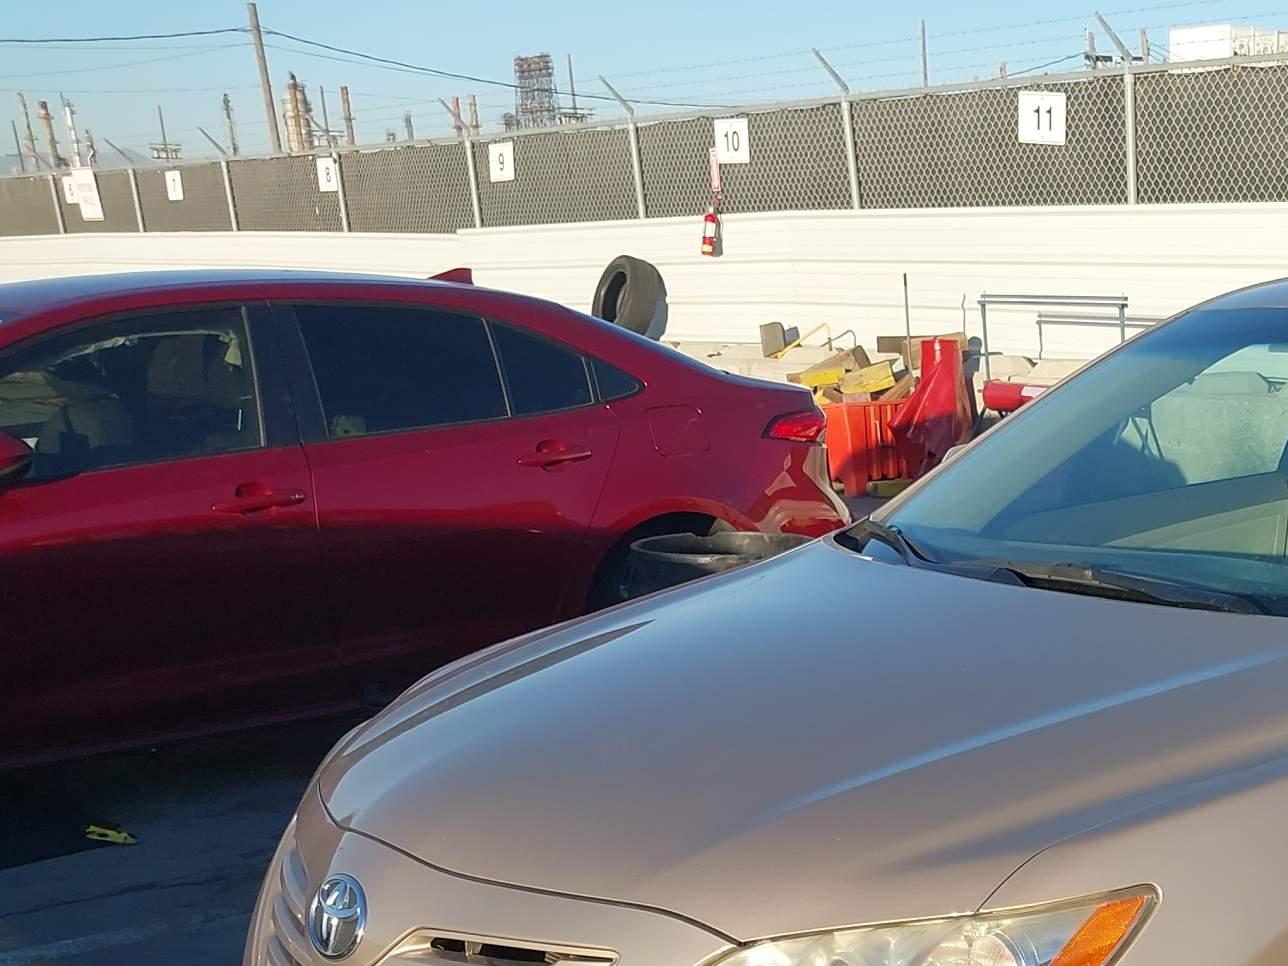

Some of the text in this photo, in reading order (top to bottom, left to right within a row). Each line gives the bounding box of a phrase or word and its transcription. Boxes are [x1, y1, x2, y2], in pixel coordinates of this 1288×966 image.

[1033, 105, 1053, 132] 11
[723, 130, 740, 153] 10
[498, 152, 505, 172] 9
[325, 166, 332, 183] 8
